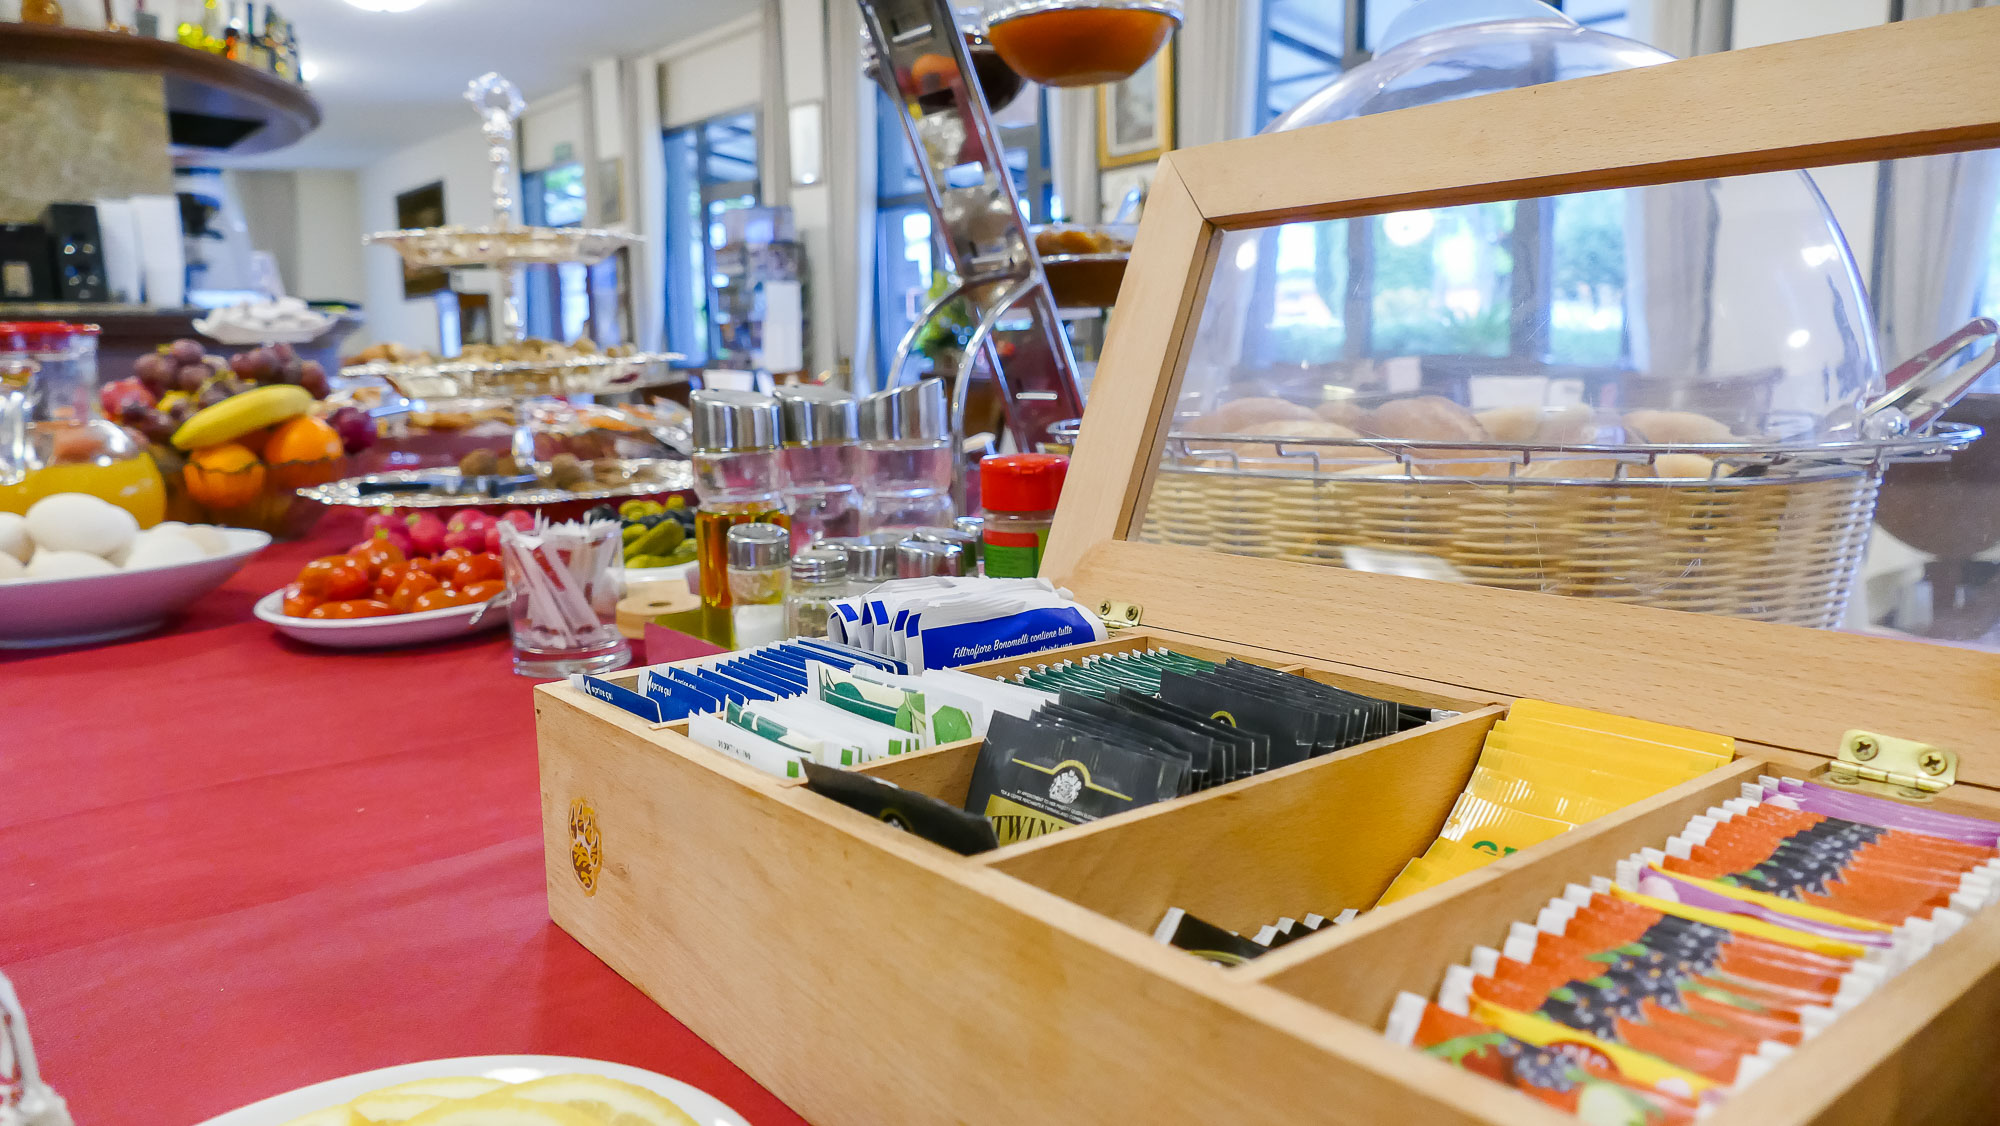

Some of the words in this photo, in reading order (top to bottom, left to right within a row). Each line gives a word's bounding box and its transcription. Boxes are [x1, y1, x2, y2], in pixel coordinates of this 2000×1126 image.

[952, 645, 992, 660] Filtrofiore
[993, 633, 1029, 651] Bonomelli
[1030, 630, 1057, 643] contiene
[1058, 625, 1073, 637] tutte
[992, 815, 1064, 841] TWIN
